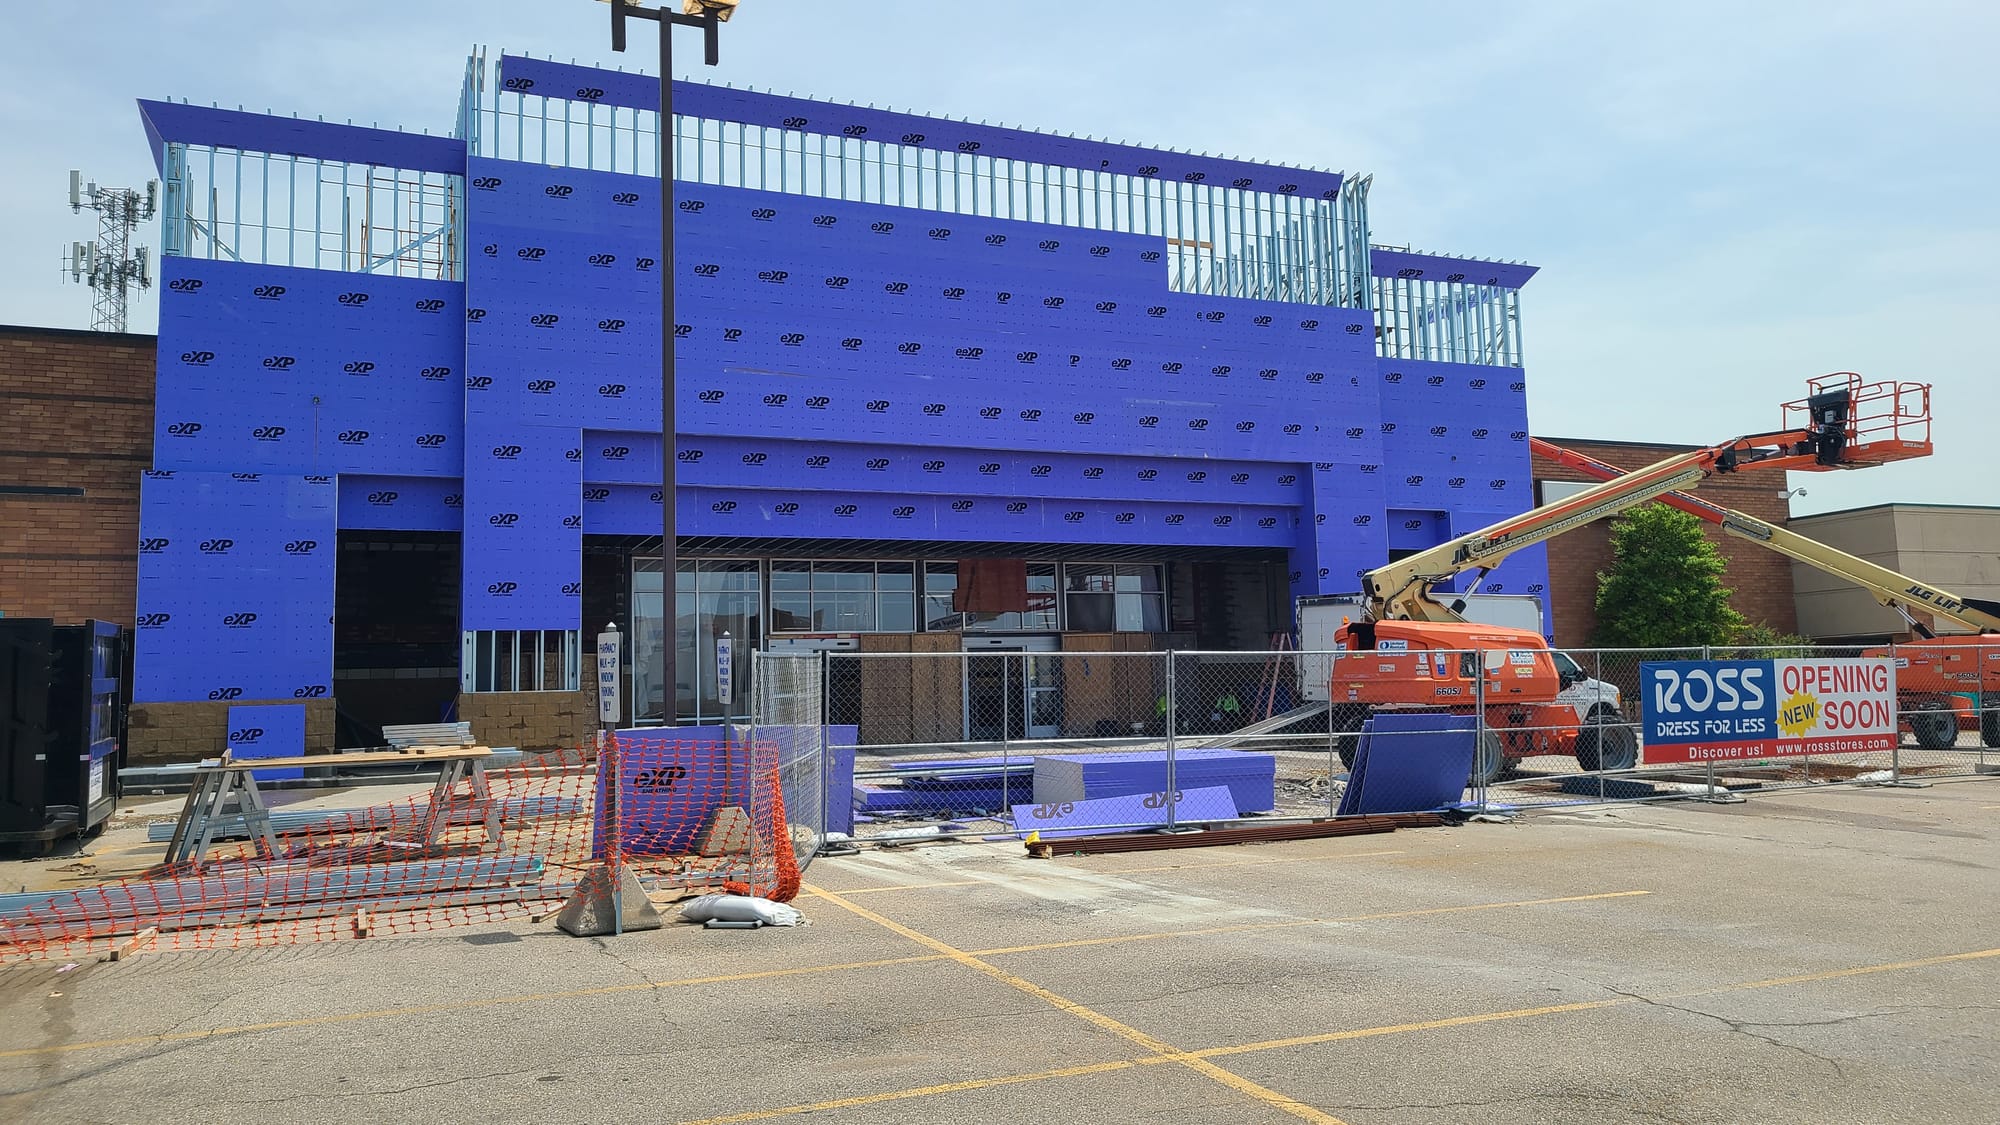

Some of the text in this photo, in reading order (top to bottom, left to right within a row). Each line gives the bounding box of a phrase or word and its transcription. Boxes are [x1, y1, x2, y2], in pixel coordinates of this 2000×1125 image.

[506, 78, 534, 89] eXP
[577, 88, 604, 98] eXP
[783, 117, 807, 127] eXP
[843, 125, 867, 135] eXP
[902, 134, 925, 143] eXP
[958, 141, 980, 150] eXP
[1138, 166, 1159, 174] eXP
[1185, 172, 1205, 181] eXP
[473, 177, 501, 188] eXP
[1233, 178, 1252, 187] eXP
[546, 185, 572, 195] eXP
[1279, 183, 1297, 193] eXP
[613, 193, 639, 203] eXP
[680, 200, 704, 210] eXP
[752, 209, 776, 218] eXP
[813, 216, 836, 224] eXP
[872, 222, 893, 231] eXP
[929, 228, 950, 237] eXP
[985, 235, 1006, 243] eXP
[1039, 240, 1059, 248] eXP
[518, 248, 545, 258] eXP
[1090, 246, 1110, 254] eXP
[589, 254, 615, 264] eXP
[1141, 251, 1160, 259] eXP
[695, 264, 719, 274] eXP
[826, 277, 849, 286] eXP
[1447, 274, 1464, 282] eXP
[170, 279, 202, 290] eXP
[885, 282, 908, 292] eXP
[254, 286, 285, 297] eXP
[943, 288, 965, 297] eXP
[339, 293, 368, 304] eXP
[1044, 297, 1064, 305] eXP
[416, 299, 445, 310] eXP
[1096, 302, 1116, 310] eXP
[1148, 307, 1167, 315] eXP
[531, 314, 558, 324] eXP
[1206, 312, 1225, 320] eXP
[1254, 316, 1272, 324] eXP
[599, 319, 625, 329] eXP
[1301, 320, 1318, 328] eXP
[1346, 324, 1363, 332] eXP
[781, 333, 804, 343] eXP
[898, 343, 921, 352] eXP
[181, 351, 214, 363] eXP
[1017, 352, 1037, 360] eXP
[263, 356, 295, 367] eXP
[1112, 359, 1131, 367] eXP
[1162, 362, 1182, 370] eXP
[344, 362, 374, 374] eXP
[421, 367, 450, 377] eXP
[1212, 366, 1230, 374] eXP
[1260, 369, 1278, 377] eXP
[1306, 373, 1324, 381] eXP
[1386, 373, 1401, 381] eXP
[1428, 376, 1444, 384] eXP
[1470, 379, 1485, 387] eXP
[528, 380, 556, 391] eXP
[599, 384, 625, 394] eXP
[699, 390, 724, 400] eXP
[763, 394, 787, 404] eXP
[806, 397, 829, 406] eXP
[867, 400, 889, 409] eXP
[923, 404, 945, 413] eXP
[980, 407, 1001, 416] eXP
[1021, 410, 1041, 418] eXP
[1074, 413, 1094, 421] eXP
[1139, 416, 1158, 424] eXP
[1189, 419, 1208, 427] eXP
[168, 423, 201, 434] eXP
[1236, 422, 1255, 430] eXP
[1284, 424, 1301, 432] eXP
[1431, 426, 1447, 434] eXP
[253, 427, 285, 438] eXP
[338, 431, 369, 441] eXP
[1347, 428, 1363, 436] eXP
[1472, 429, 1488, 437] eXP
[1511, 430, 1526, 438] eXP
[417, 435, 446, 445] eXP
[493, 446, 521, 456] eXP
[603, 447, 629, 457] eXP
[678, 450, 703, 460] eXP
[743, 453, 767, 463] eXP
[806, 456, 830, 465] eXP
[867, 459, 889, 468] eXP
[923, 461, 945, 470] eXP
[979, 463, 1000, 472] eXP
[1031, 465, 1051, 473] eXP
[1084, 468, 1103, 476] eXP
[1138, 470, 1157, 478] eXP
[1188, 472, 1206, 480] eXP
[1231, 473, 1249, 481] eXP
[1278, 475, 1295, 483] eXP
[1407, 476, 1423, 484] eXP
[368, 492, 398, 502] eXP
[583, 489, 609, 499] eXP
[712, 501, 737, 511] eXP
[775, 503, 799, 512] eXP
[834, 505, 857, 514] eXP
[952, 500, 973, 510] eXP
[1006, 502, 1027, 512] eXP
[893, 507, 915, 516] eXP
[1065, 512, 1084, 520] eXP
[490, 514, 518, 524] eXP
[1116, 513, 1135, 521] eXP
[1166, 514, 1184, 522] eXP
[1214, 516, 1232, 524] eXP
[1354, 515, 1370, 523] eXP
[1259, 518, 1276, 526] eXP
[1405, 520, 1421, 528] eXP
[200, 540, 233, 551] eXP
[285, 541, 316, 552] eXP
[488, 582, 517, 593] eXP
[1487, 584, 1502, 592] eXP
[1528, 584, 1543, 592] eXP
[1905, 585, 1969, 613] JLG LIFT
[137, 614, 170, 625] eXP
[224, 613, 257, 625] eXP
[1782, 664, 1888, 695] OPENING
[208, 688, 242, 700] eXP
[294, 686, 326, 698] eXP
[1436, 687, 1462, 696] 660SJ
[1655, 668, 1764, 713] ROSS
[1783, 701, 1815, 727] NEW
[1823, 699, 1890, 730] SOON
[1657, 718, 1766, 737] DRESS FOR LESS
[230, 729, 263, 741] eXP
[1689, 738, 1889, 759] Discover us! www.rossstores.com
[634, 766, 686, 788] eXP
